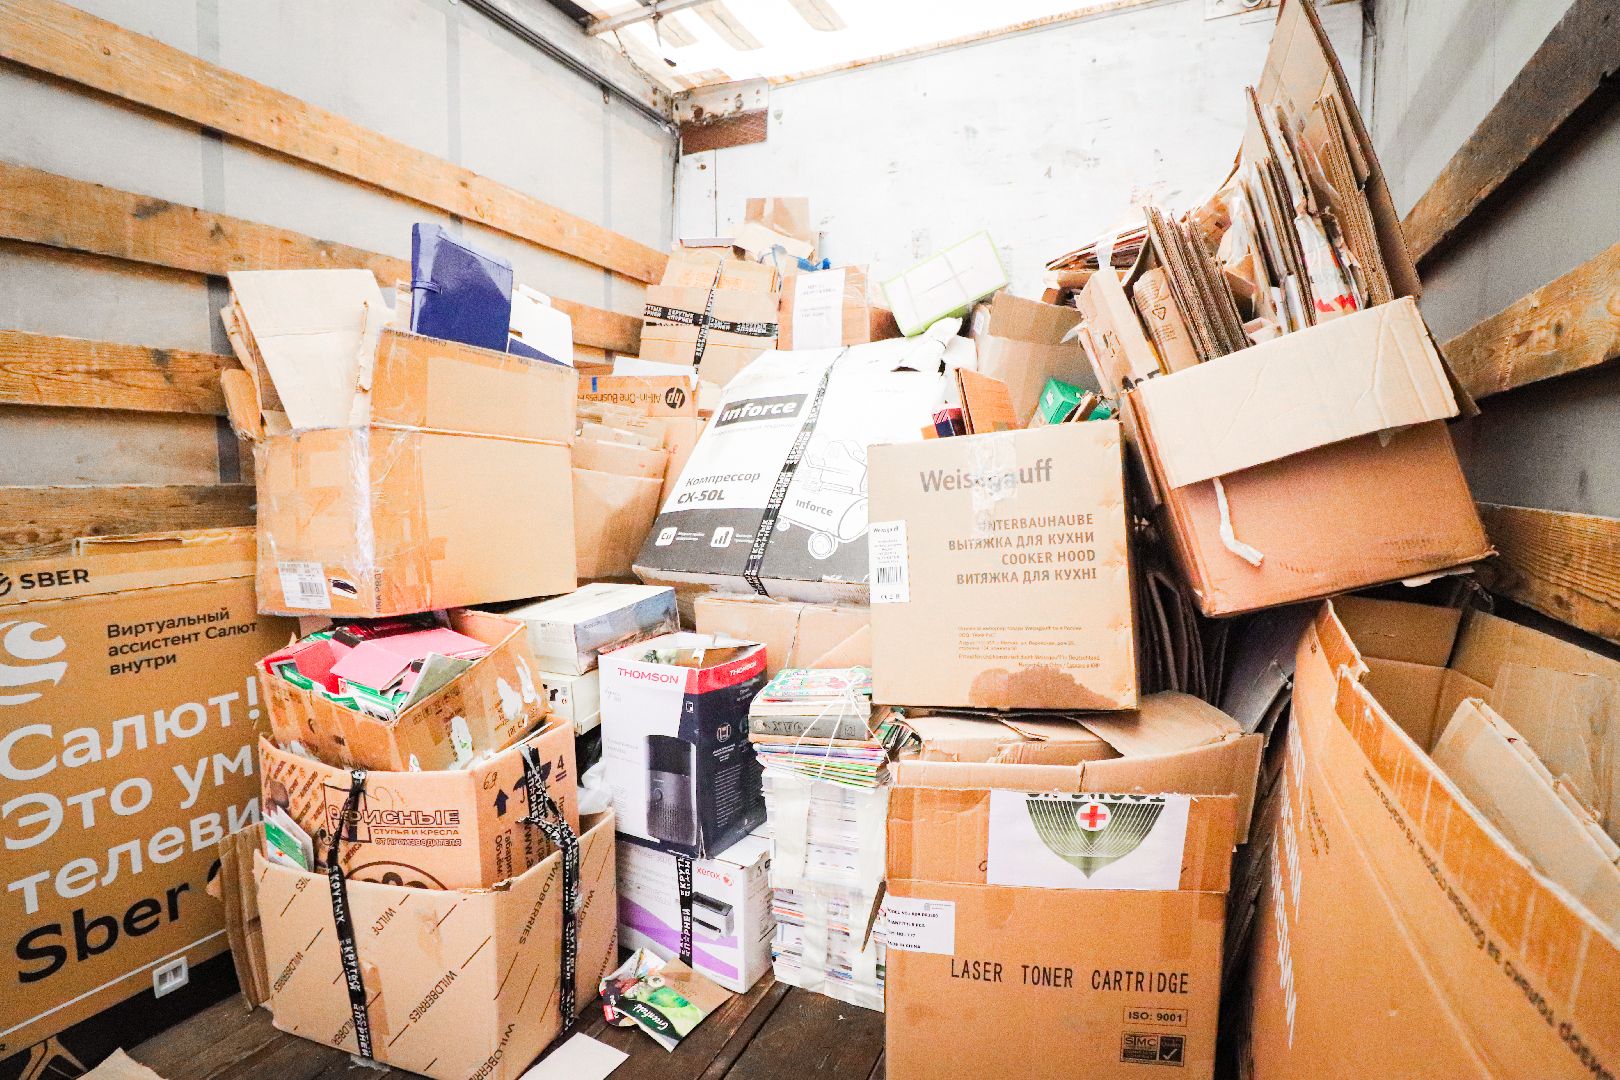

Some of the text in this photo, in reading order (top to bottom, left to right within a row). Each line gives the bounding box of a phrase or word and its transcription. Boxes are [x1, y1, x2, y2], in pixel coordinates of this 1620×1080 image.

[685, 472, 761, 488] Компрессор
[949, 532, 1095, 551] ВЫТЯЖКА ДЛЯ КУХНИ
[1002, 549, 1096, 566] COOKER HOOD
[20, 569, 89, 590] SBER
[957, 567, 1097, 585] ВИТЯЖКА ДЛЯ КУХНІ
[107, 608, 230, 638] Виртуальный
[108, 621, 257, 657] ассистент Салют
[110, 651, 177, 676] внутри
[617, 667, 679, 684] THOMSON
[0, 676, 260, 782] Салют!
[2, 777, 152, 851] Это
[696, 866, 721, 880] xerox
[518, 859, 562, 945] WILDBERRIES
[15, 881, 190, 984] Sber
[951, 958, 1189, 994] LASER TONER CARTRIDGE
[408, 969, 457, 1024] WILDBERRIES
[1128, 1011, 1182, 1022] ISO: 9001
